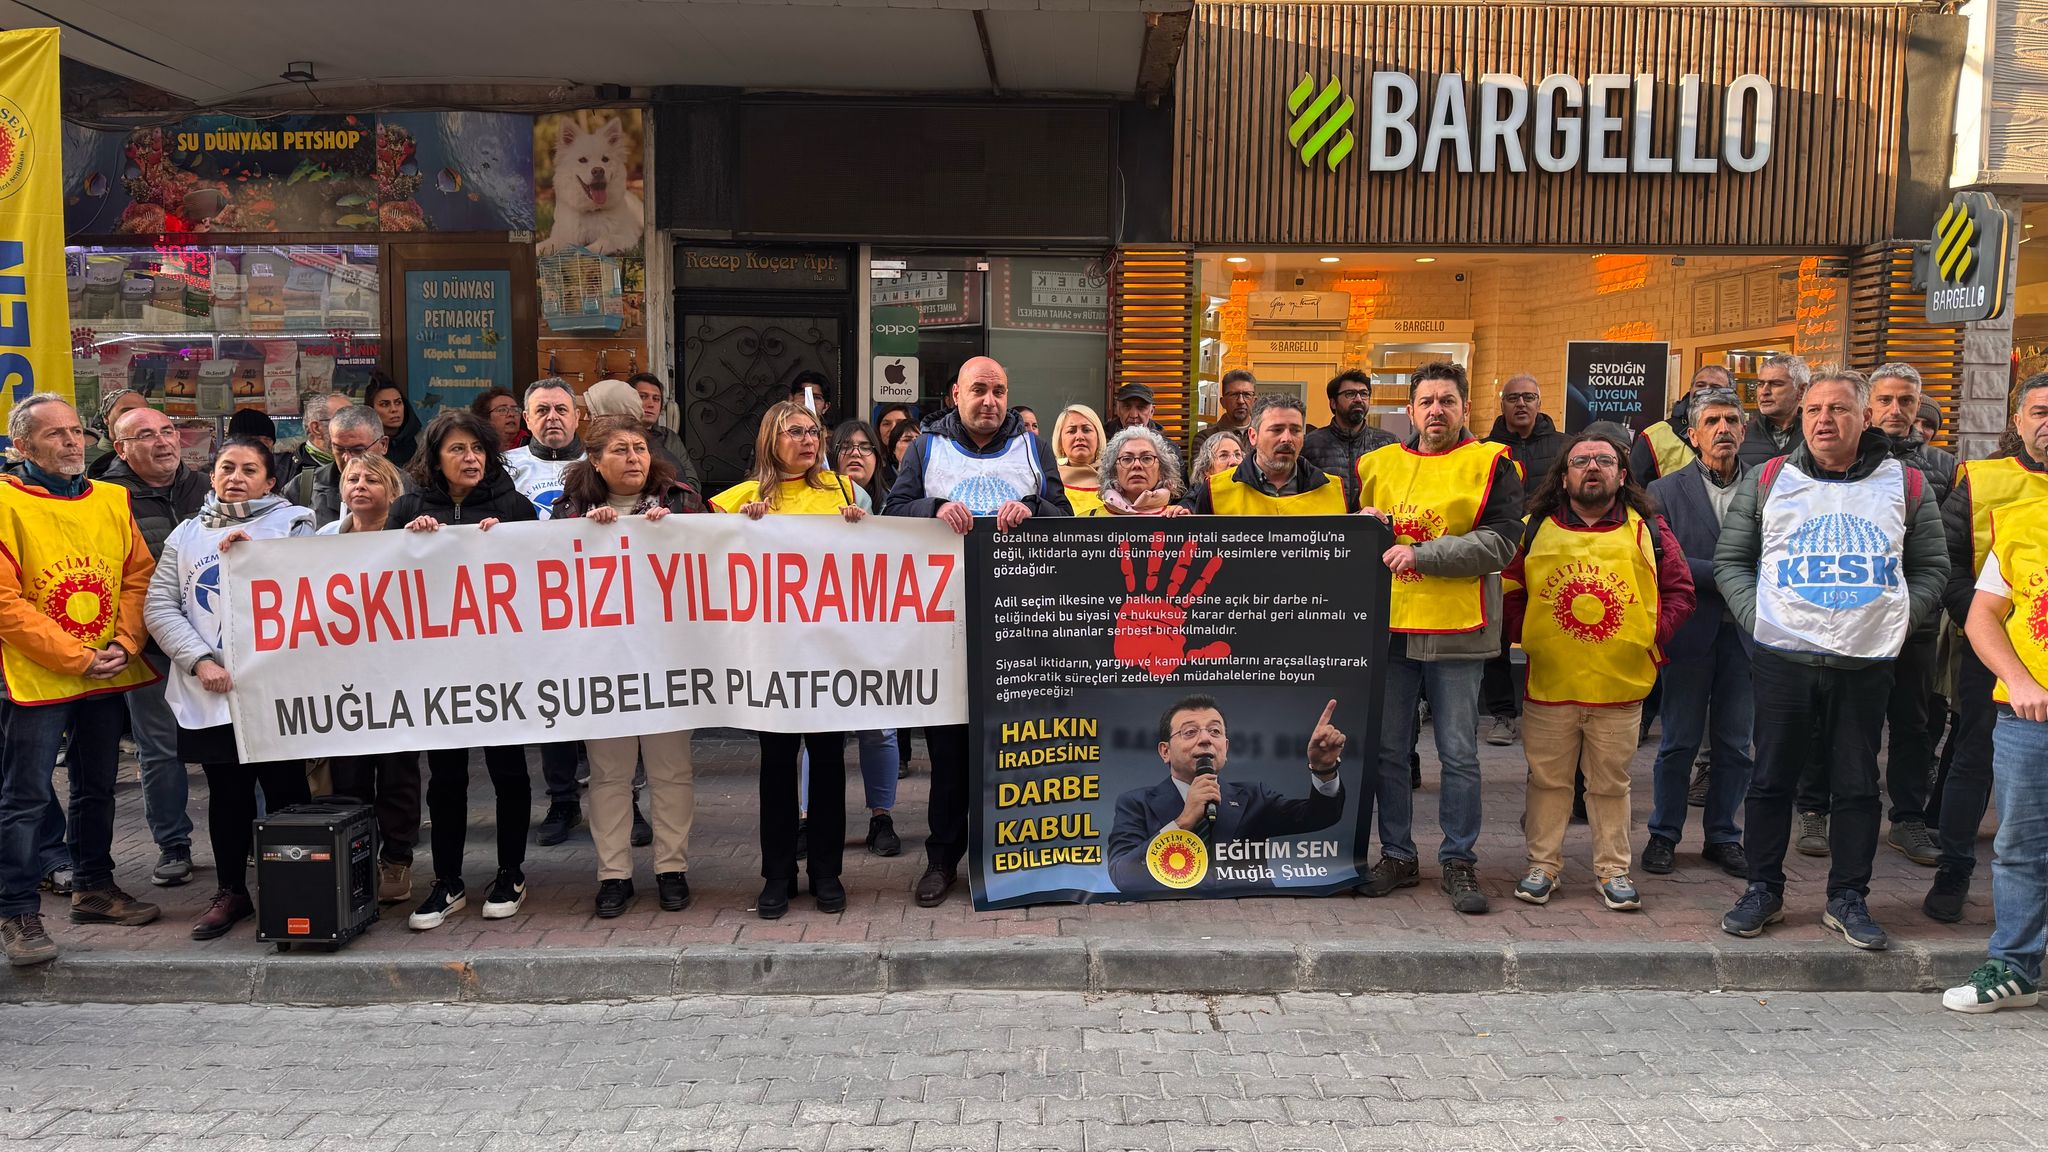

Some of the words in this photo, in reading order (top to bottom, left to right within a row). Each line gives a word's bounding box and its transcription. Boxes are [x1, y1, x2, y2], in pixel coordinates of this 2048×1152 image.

[1369, 71, 1774, 174] BARGELLO
[177, 132, 200, 151] SU
[205, 127, 278, 151] DÜNYASI
[283, 130, 360, 150] PETSHOP
[685, 251, 741, 272] Recep
[745, 252, 799, 273] Koçer
[803, 253, 839, 273] Apt.
[422, 280, 438, 299] SU
[443, 276, 495, 299] DÜNYASI
[1933, 285, 1985, 311] BARGELLO
[424, 309, 495, 328] PETMARKET
[1402, 320, 1445, 332] BARGELLO
[875, 324, 916, 335] oppo
[448, 334, 472, 345] Kedi
[1278, 341, 1318, 352] BARGELLO
[423, 348, 456, 361] Köpek
[458, 348, 496, 360] Maması
[453, 365, 467, 373] ve
[1589, 361, 1646, 374] SEVDİĞİN
[1588, 376, 1645, 386] KOKULAR
[880, 386, 913, 395] iPhone
[1595, 389, 1638, 400] UYGUN
[1588, 401, 1642, 412] FİYATLAR
[1052, 532, 1103, 543] alınması
[1107, 531, 1184, 544] diplomasının
[1188, 532, 1218, 544] iptali
[1221, 532, 1264, 543] sadece
[993, 548, 1025, 561] değil,
[1028, 547, 1078, 558] iktidarla
[1081, 550, 1106, 560] aynı
[1110, 547, 1186, 560] düşünmeyen
[1190, 548, 1213, 558] tüm
[1217, 547, 1277, 558] kesimlere
[1281, 547, 1331, 560] verilmiş
[1334, 547, 1351, 558] bir
[993, 562, 1058, 578] gözdağıdır.
[1776, 554, 1899, 589] KESK
[28, 555, 91, 603] EĞİTİM
[182, 570, 195, 606] SOSYAL
[194, 553, 220, 570] HİZM
[1539, 560, 1600, 599] EĞİTİM
[1606, 572, 1639, 605] SEN
[251, 562, 523, 652] BASKILAR
[537, 536, 635, 631] BİZİ
[647, 552, 956, 623] YILDIRAMAZ
[994, 596, 1018, 608] Adil
[1021, 595, 1056, 609] seçim
[1059, 594, 1105, 606] ilkesine
[1108, 596, 1122, 605] ve
[1126, 594, 1162, 605] halkın
[1166, 594, 1221, 605] iradesine
[1225, 594, 1250, 607] açık
[1253, 594, 1270, 605] bir
[1273, 594, 1308, 605] darbe
[1822, 590, 1858, 604] 1995
[994, 611, 1056, 625] teliğindeki
[1059, 611, 1073, 621] bu
[1076, 610, 1110, 623] siyasi
[1113, 612, 1127, 620] ve
[1131, 609, 1188, 620] hukuksuz
[1191, 609, 1224, 620] karar
[1228, 609, 1267, 620] derhal
[1270, 609, 1294, 622] geri
[1298, 609, 1346, 620] alınmalı
[1353, 612, 1368, 620] ve
[995, 626, 1049, 641] gözaltına
[1052, 626, 1103, 638] alınanlar
[1107, 625, 1153, 636] serbest
[1156, 624, 1237, 635] bırakılmalıdır.
[996, 656, 1037, 671] Siyasal
[1040, 657, 1092, 669] iktidarın,
[1095, 658, 1134, 670] yargıyı
[1137, 658, 1151, 666] ve
[1154, 656, 1187, 666] kamu
[1191, 655, 1260, 666] kurumlarını
[1263, 655, 1368, 668] araçsallaştırarak
[996, 672, 1062, 686] demokratik
[1065, 672, 1118, 686] süreçleri
[1121, 671, 1180, 684] zedeleyen
[1184, 670, 1276, 681] müdahalelerine
[1279, 670, 1315, 683] boyun
[275, 683, 415, 736] MUĞLA
[424, 682, 527, 726] KESK
[537, 668, 717, 729] ŞUBELER
[726, 668, 939, 709] PLATFORMU
[996, 685, 1074, 702] eğmeyeceğiz!
[1002, 717, 1097, 744] HALKIN
[999, 742, 1100, 769] İRADESİNE
[999, 775, 1099, 808] DARBE
[998, 813, 1100, 845] KABUL
[1185, 837, 1203, 854] SEN
[1215, 838, 1291, 861] EĞİTİM
[1296, 840, 1338, 858] SEN
[995, 845, 1102, 871] EDİLEMEZ!
[1215, 864, 1277, 883] Muğla
[1281, 863, 1328, 881] Şube
